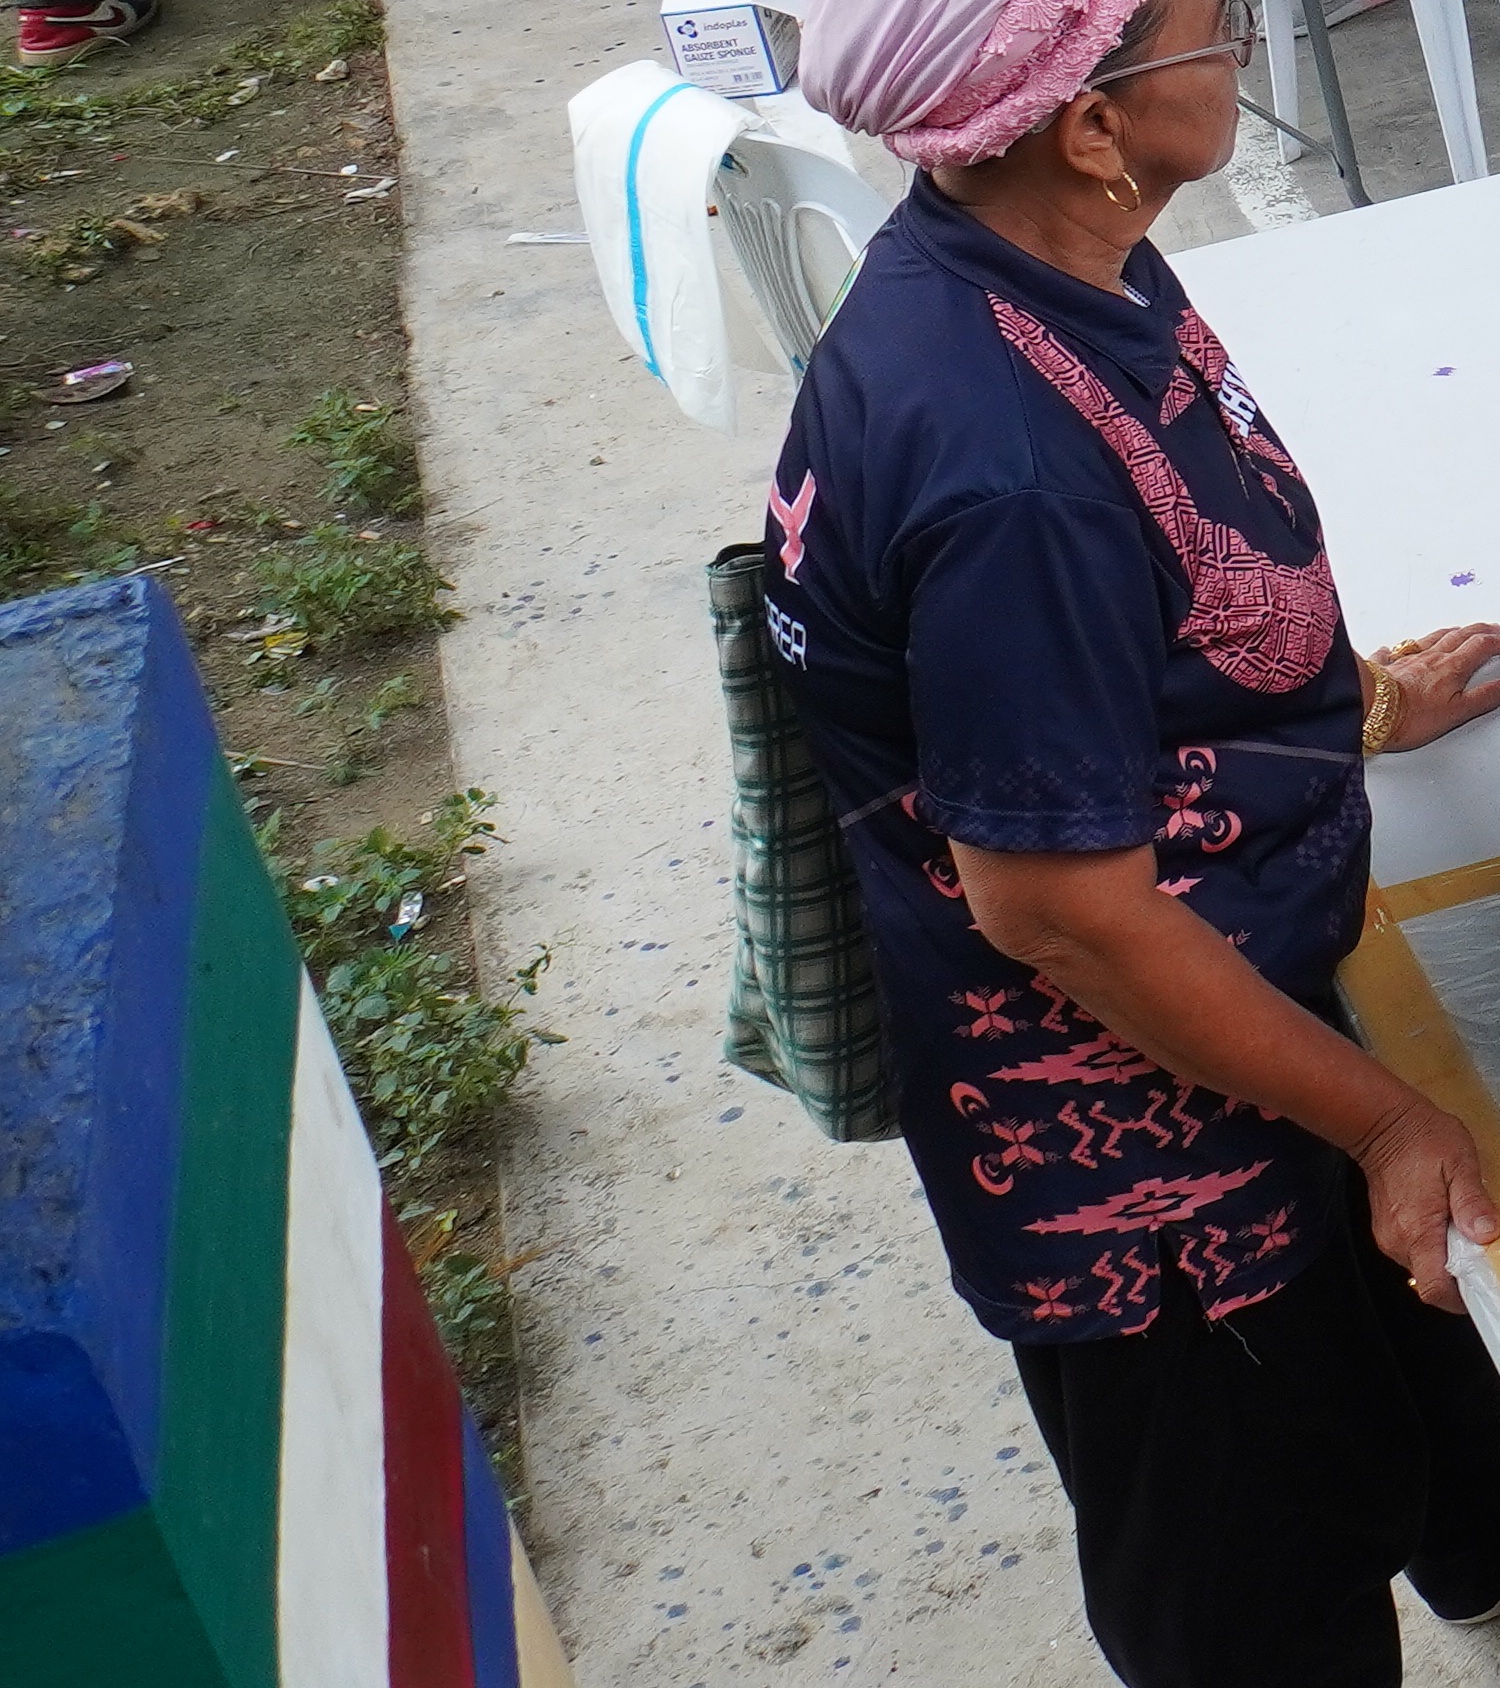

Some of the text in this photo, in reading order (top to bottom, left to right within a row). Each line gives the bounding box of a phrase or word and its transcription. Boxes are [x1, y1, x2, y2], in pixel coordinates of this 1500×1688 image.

[703, 19, 749, 32] indoplas
[682, 38, 739, 53] ABSORBENT
[684, 46, 758, 63] GAUZE SPONGE
